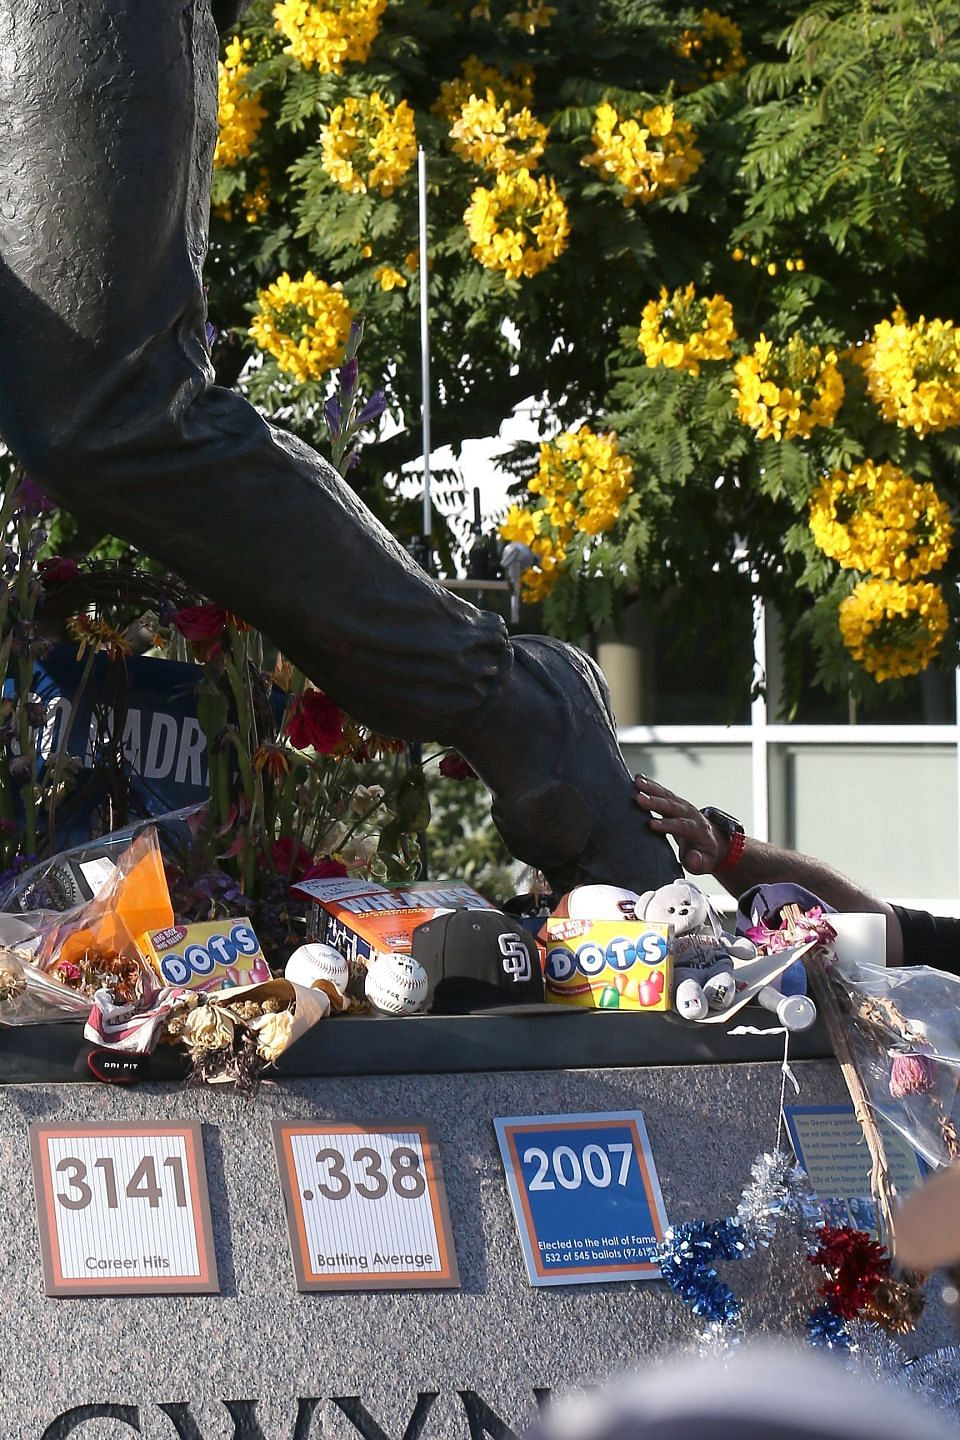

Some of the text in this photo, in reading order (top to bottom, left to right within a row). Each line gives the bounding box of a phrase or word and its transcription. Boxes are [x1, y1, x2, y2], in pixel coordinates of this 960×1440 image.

[84, 705, 212, 787] ADR
[154, 928, 178, 944] BIG BOX
[156, 941, 168, 950] BIG
[165, 928, 255, 982] DOTS
[497, 933, 531, 982] SD
[551, 935, 662, 978] DOTS
[123, 1062, 139, 1070] FIT
[303, 1147, 426, 1200] .338
[524, 1143, 633, 1191] 2007
[56, 1155, 187, 1210] 3141
[538, 1235, 657, 1251] Elected to the Hall of Fame
[545, 1246, 659, 1263] 532 of 545 ballots (97.61%)
[85, 1255, 170, 1270] Career Hits
[317, 1252, 433, 1269] Batting Average
